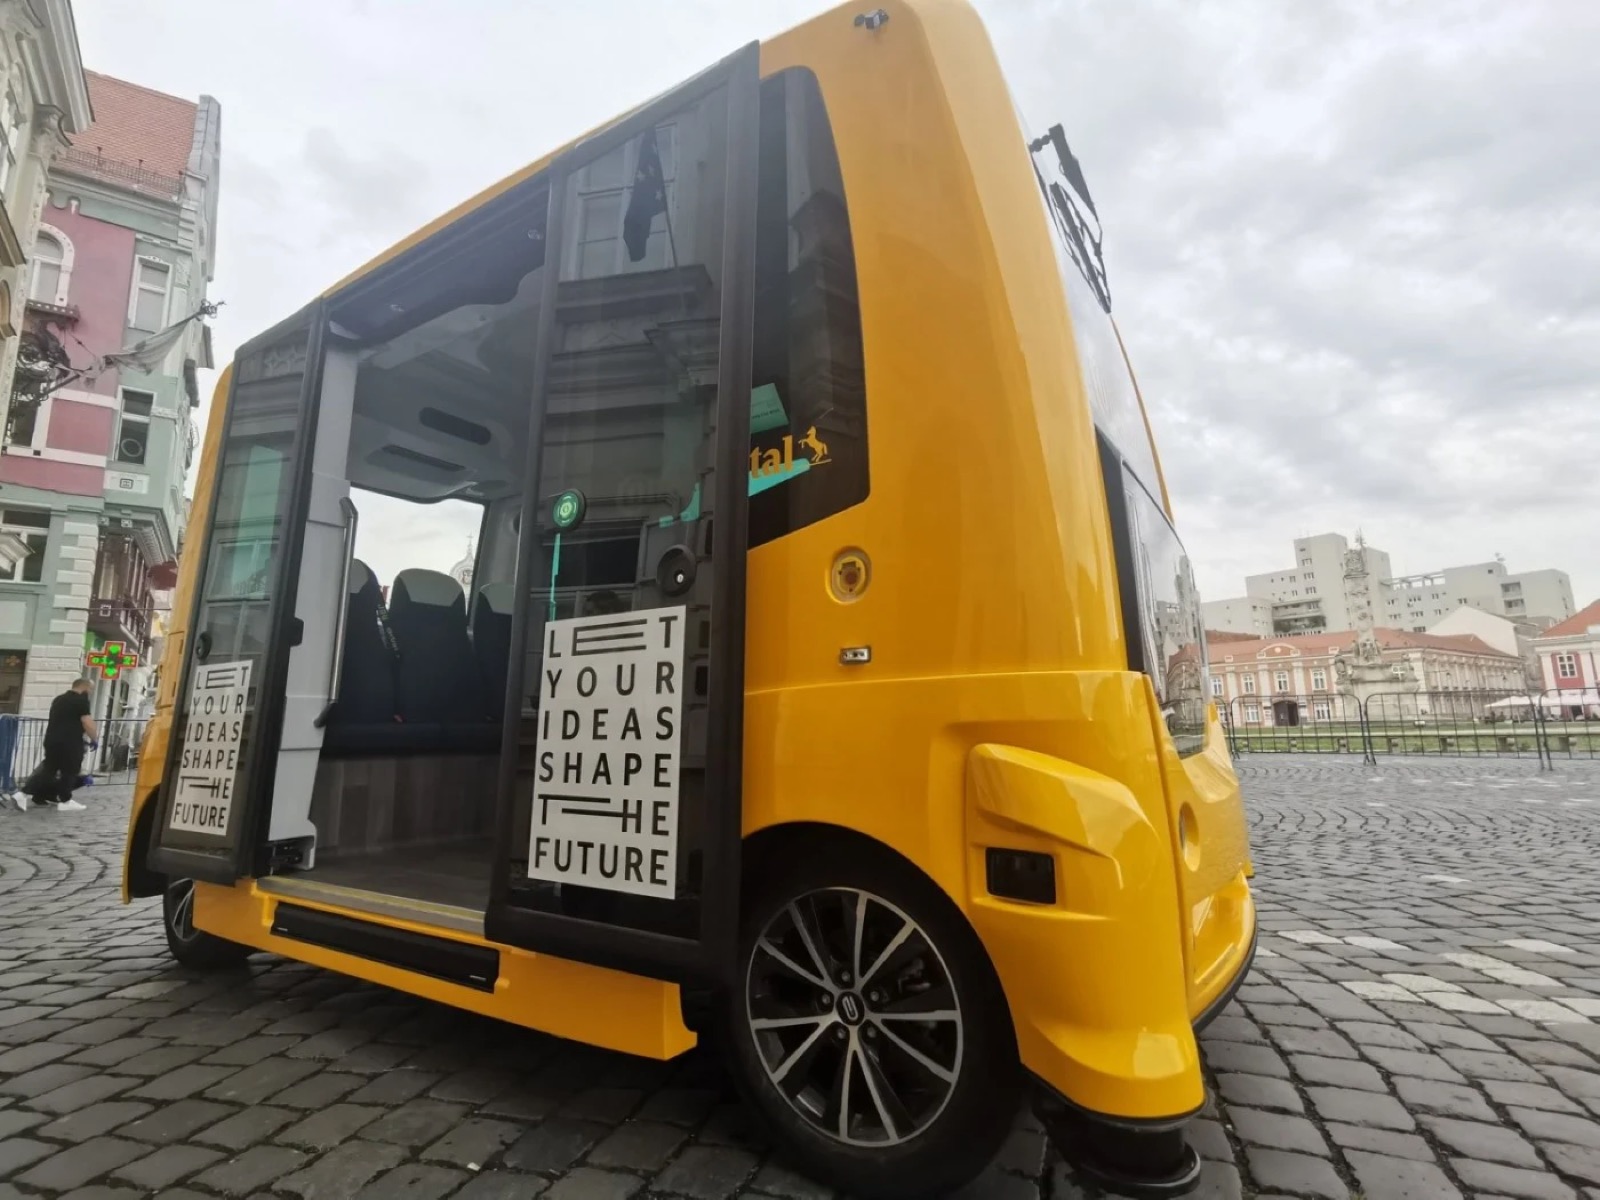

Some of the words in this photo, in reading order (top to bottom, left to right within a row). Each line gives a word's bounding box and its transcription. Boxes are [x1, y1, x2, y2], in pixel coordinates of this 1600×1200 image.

[549, 615, 678, 658] LET
[196, 666, 249, 690] LET
[547, 660, 675, 698] YOUR
[192, 693, 244, 715] YOUR
[186, 721, 240, 742] IDEAS
[543, 706, 674, 740] IDEAS
[182, 749, 236, 770] SHAPE
[538, 751, 671, 787] SHAPE
[180, 775, 232, 799] THE
[173, 802, 227, 828] FUTURE
[538, 793, 670, 836] THE
[535, 837, 669, 886] FUTURE
